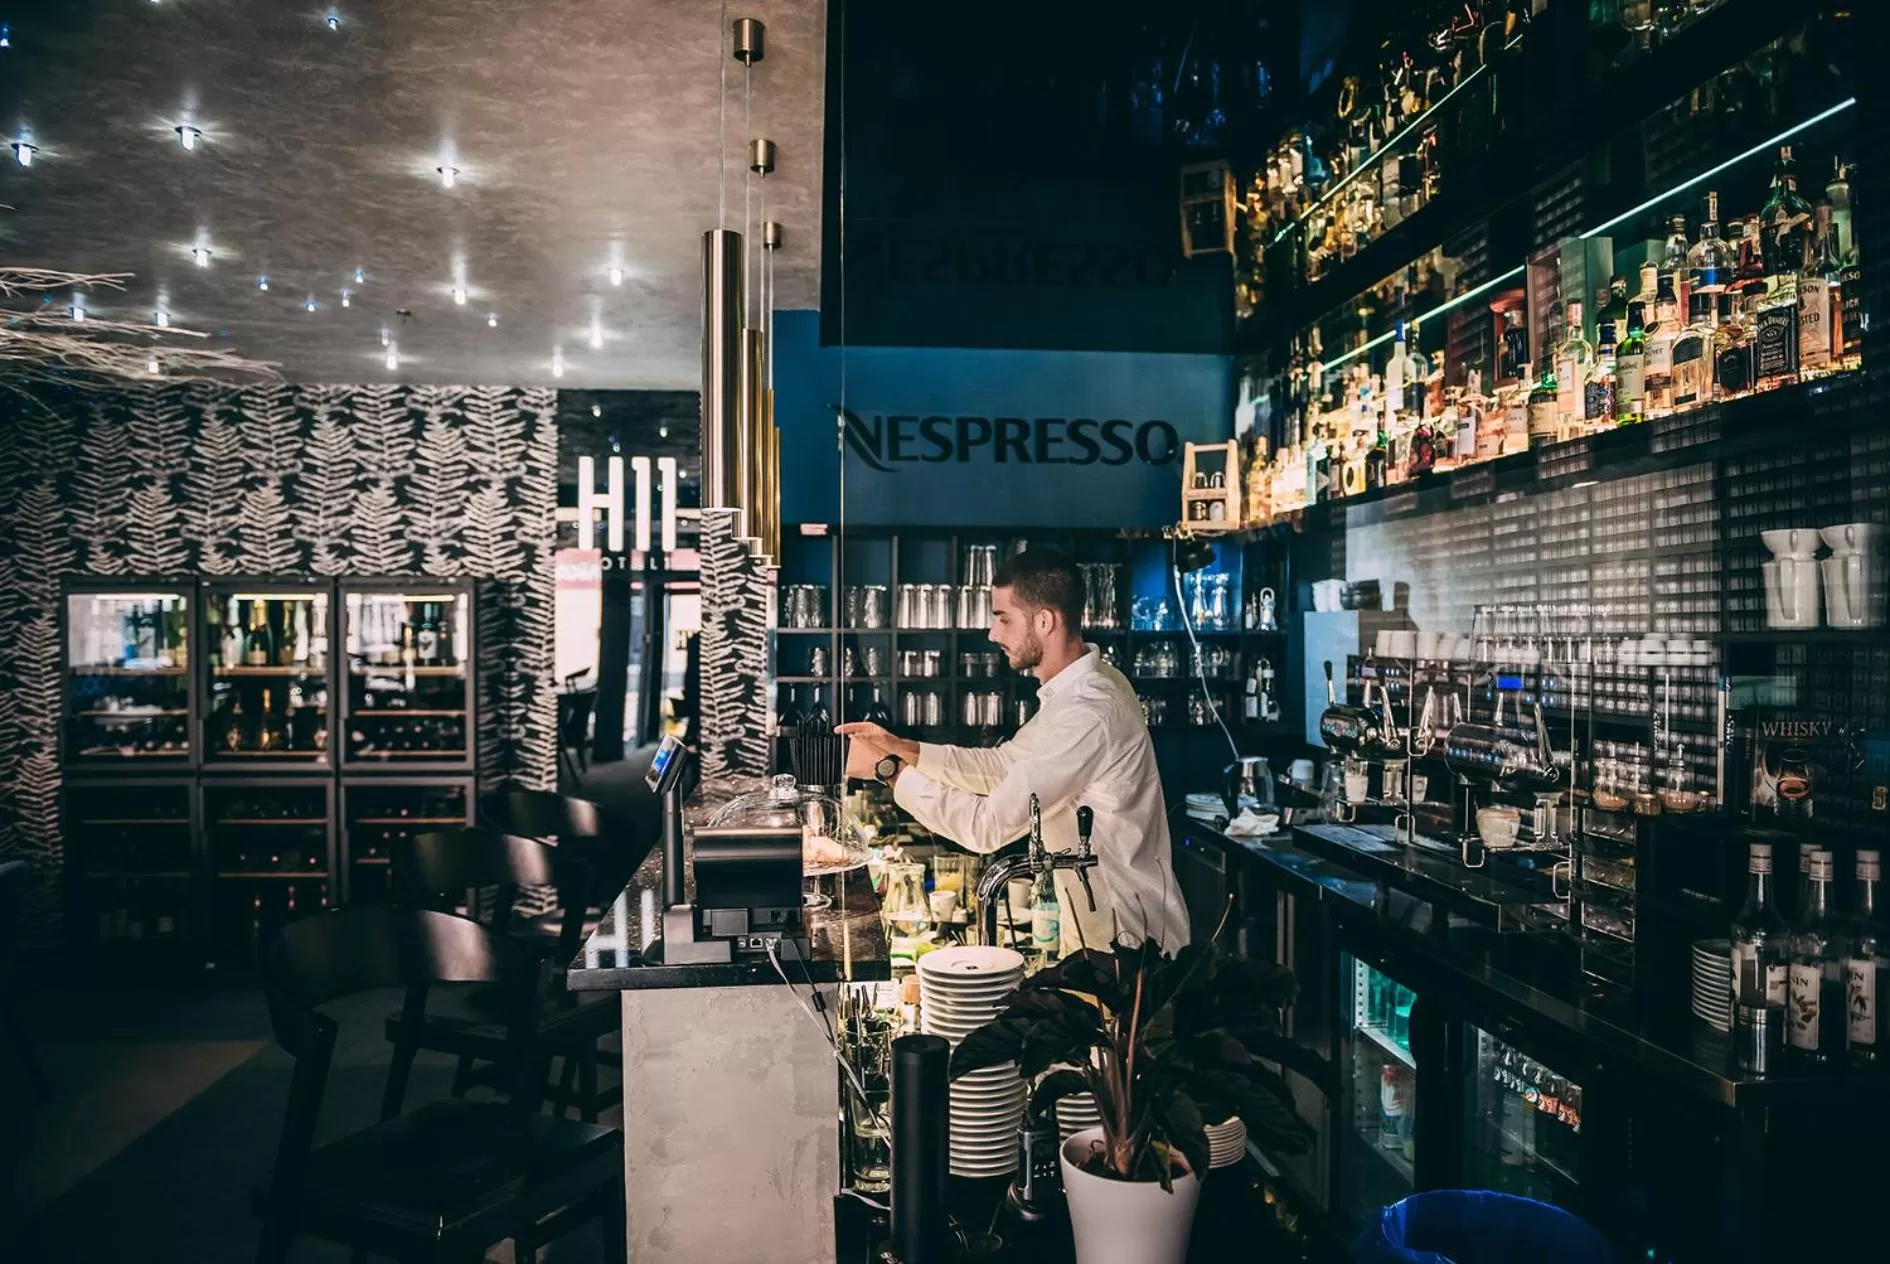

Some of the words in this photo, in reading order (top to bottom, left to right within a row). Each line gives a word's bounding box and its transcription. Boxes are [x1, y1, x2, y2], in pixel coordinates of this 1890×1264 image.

[827, 404, 1179, 472] NESPRESSO
[578, 456, 677, 552] H11
[1761, 720, 1833, 737] WHISKY
